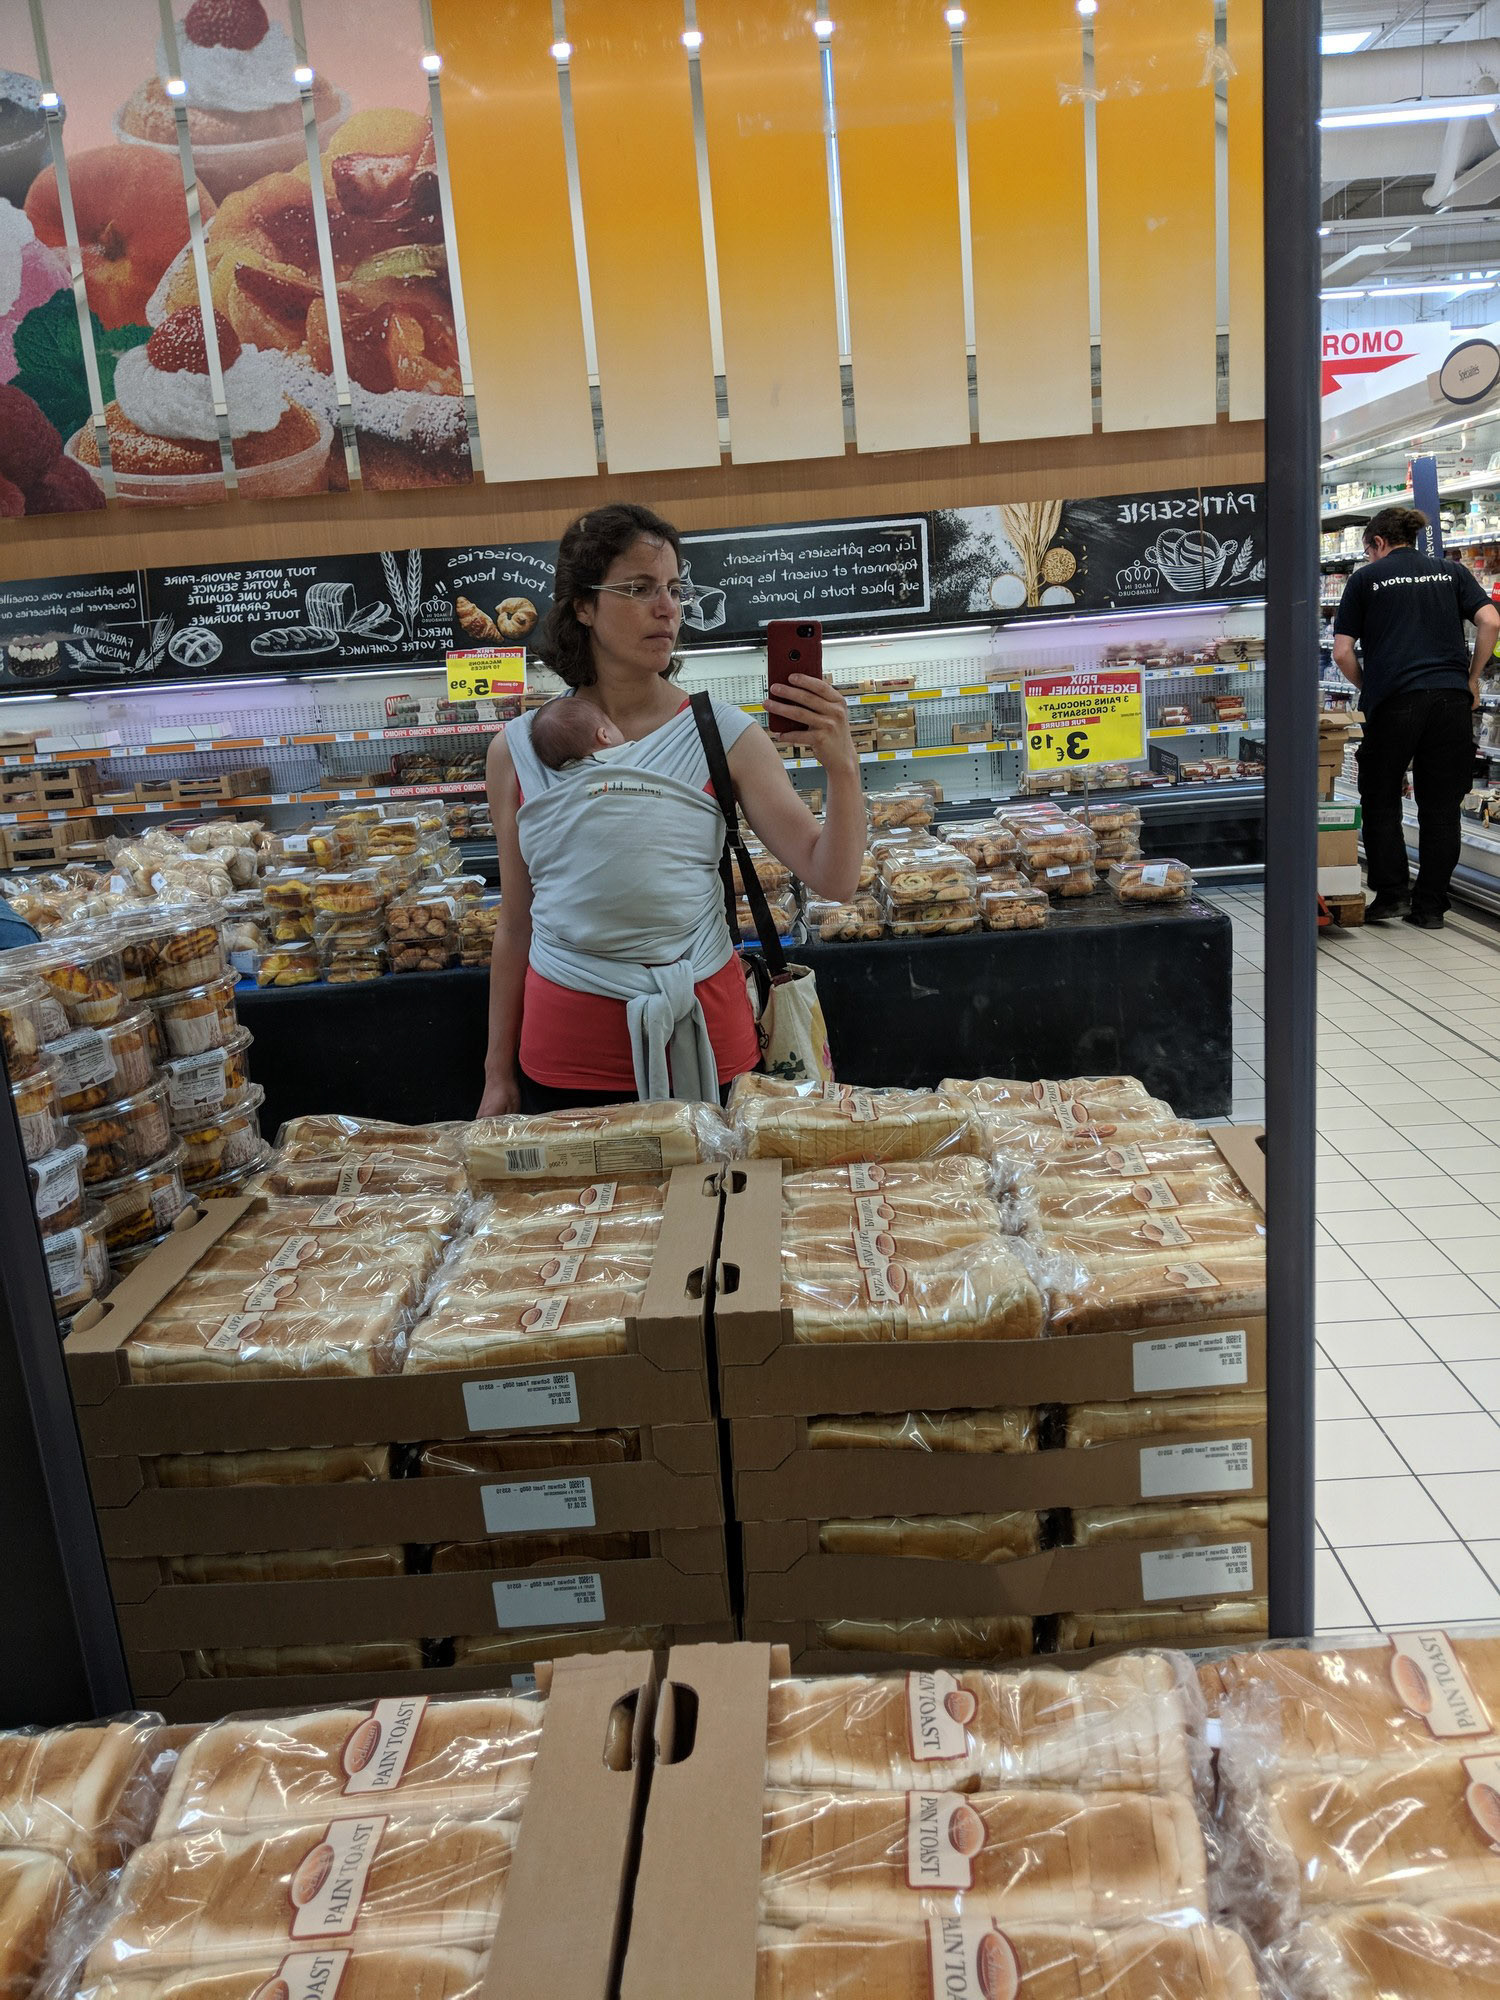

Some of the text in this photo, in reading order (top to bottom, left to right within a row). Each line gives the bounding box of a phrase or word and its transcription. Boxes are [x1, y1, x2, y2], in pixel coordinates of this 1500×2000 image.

[1323, 329, 1403, 356] ROMO
[1372, 583, 1379, 591] à
[1381, 577, 1412, 587] votre
[920, 1695, 941, 1750] TOAST
[1418, 1636, 1476, 1728] PAIN TOAST
[372, 1701, 416, 1786] PAIN TOAST
[324, 1824, 373, 1925] PAIN TOAST
[920, 1796, 941, 1878] PAIN TOAST
